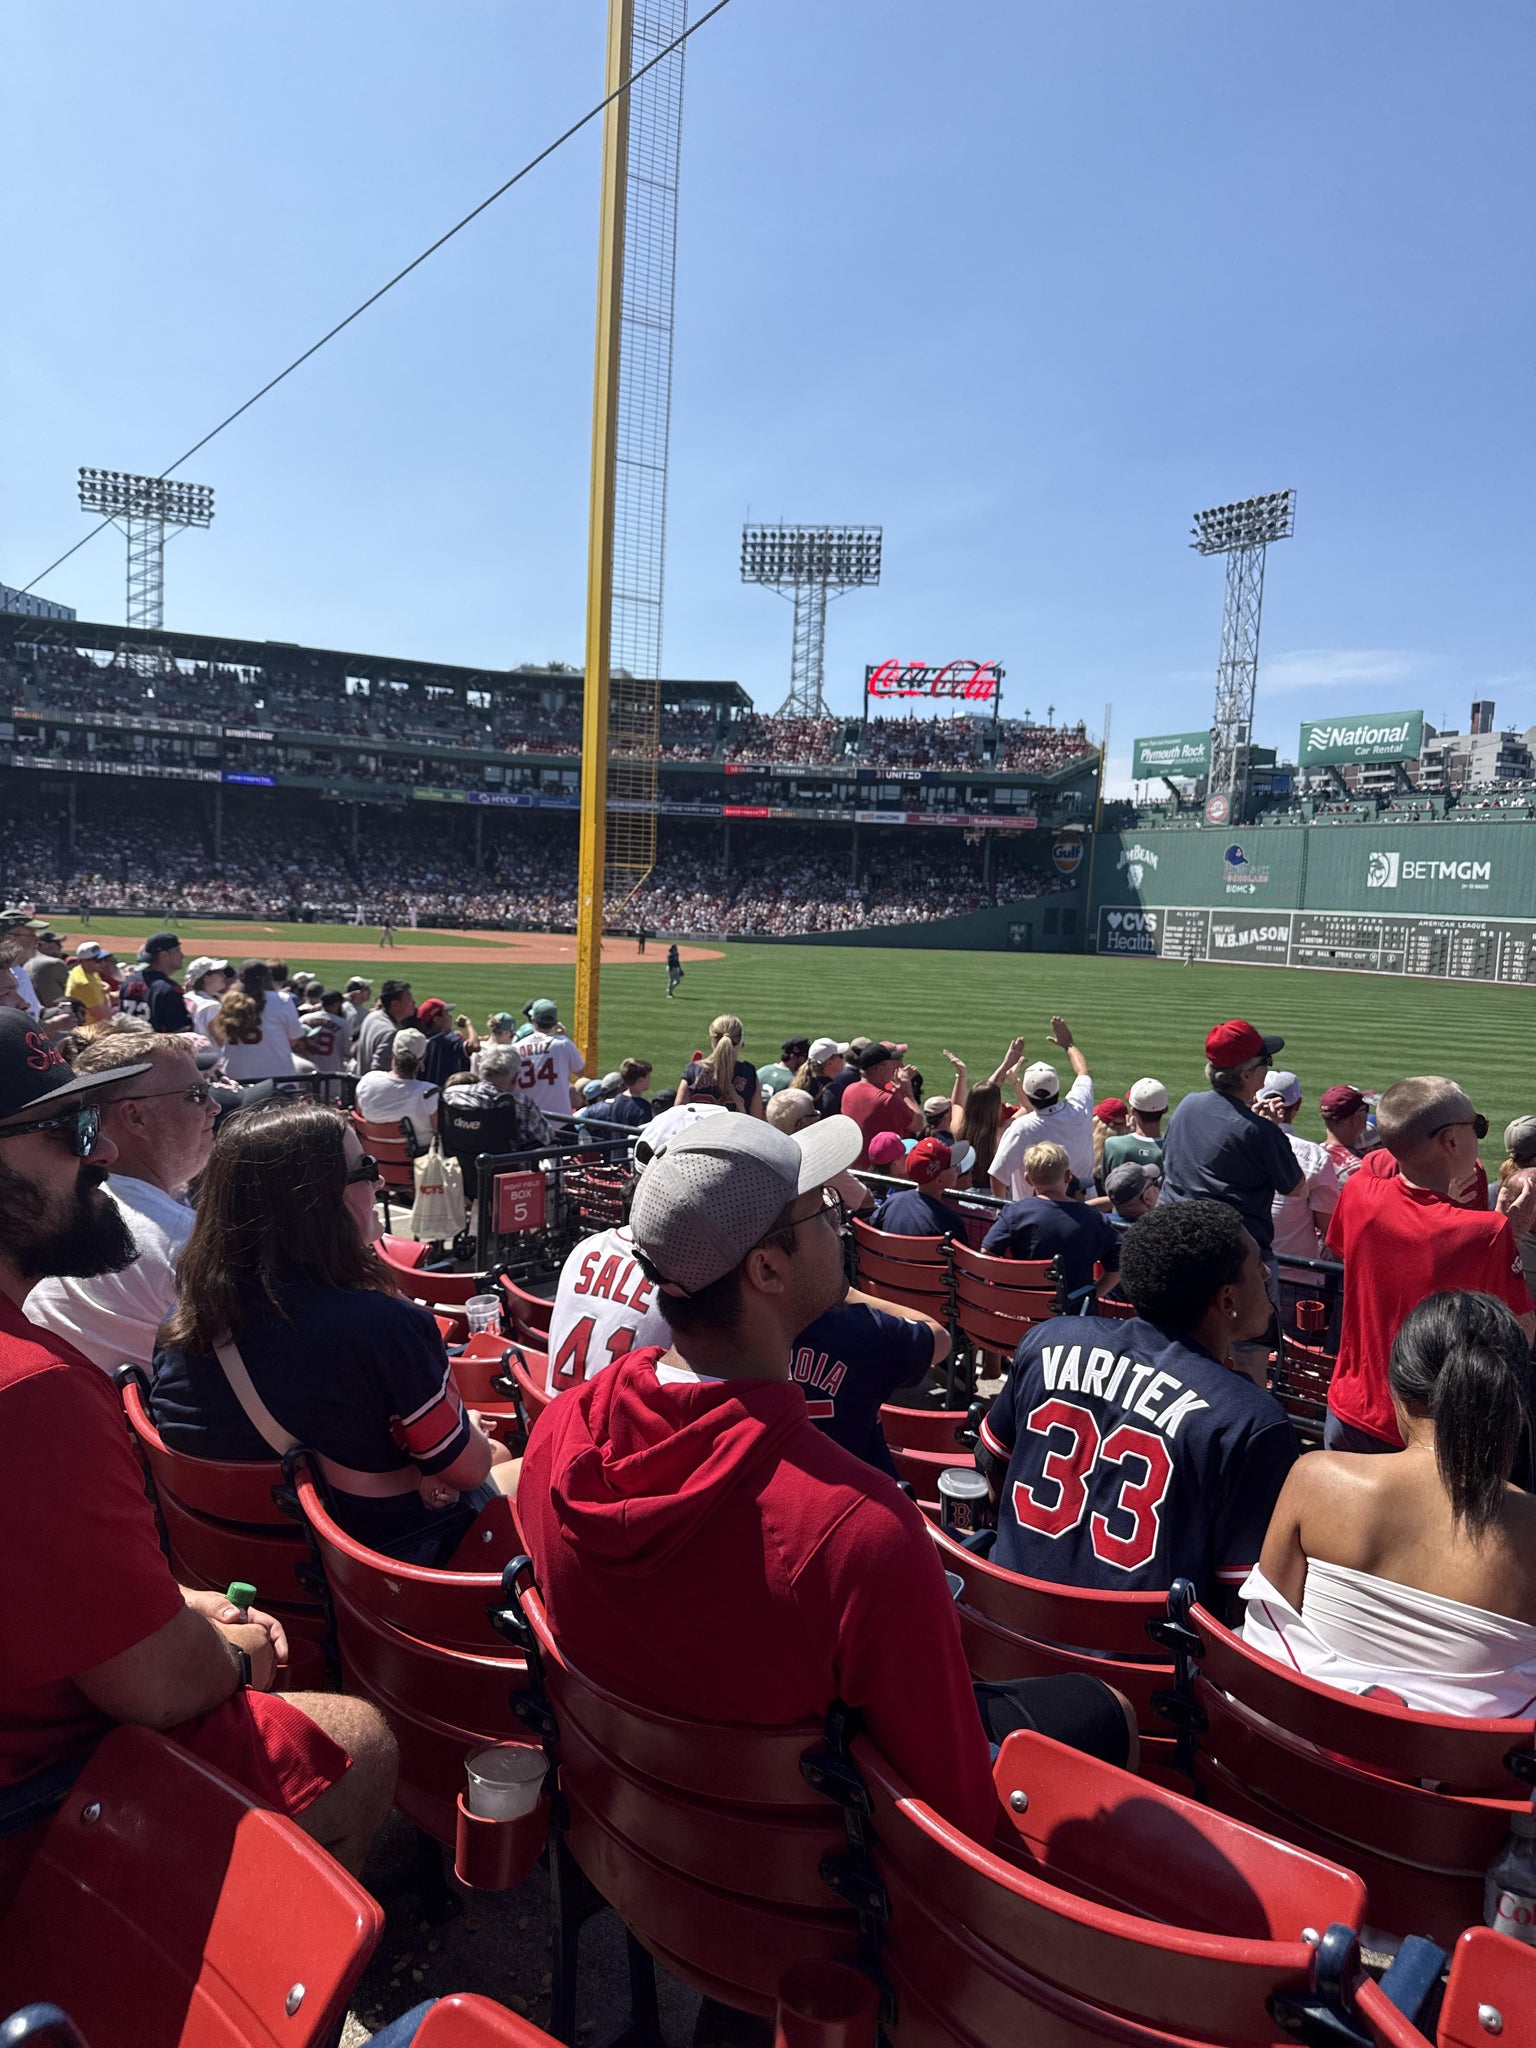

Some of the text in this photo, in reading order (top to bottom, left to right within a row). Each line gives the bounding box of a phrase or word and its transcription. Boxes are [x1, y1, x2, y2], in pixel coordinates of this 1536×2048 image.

[1329, 723, 1408, 747] National
[1140, 743, 1206, 762] Plymouth Rock
[1355, 744, 1402, 756] Car Rental
[885, 771, 922, 780] UNITED
[1053, 845, 1080, 859] Gulf
[1134, 845, 1159, 870] BEAM
[1402, 861, 1491, 881] BETMGM
[1123, 912, 1157, 932] CVS
[1107, 932, 1156, 951] Health
[1256, 944, 1272, 952] SINCE
[1335, 951, 1352, 959] STRIKE
[518, 1057, 557, 1089] 34
[454, 1117, 481, 1130] drive
[522, 1180, 539, 1188] FIELD
[510, 1189, 532, 1200] BOX
[513, 1202, 528, 1222] 5
[574, 1251, 654, 1315] SALE
[1041, 1345, 1210, 1438] VARITEK
[1012, 1397, 1174, 1572] 33
